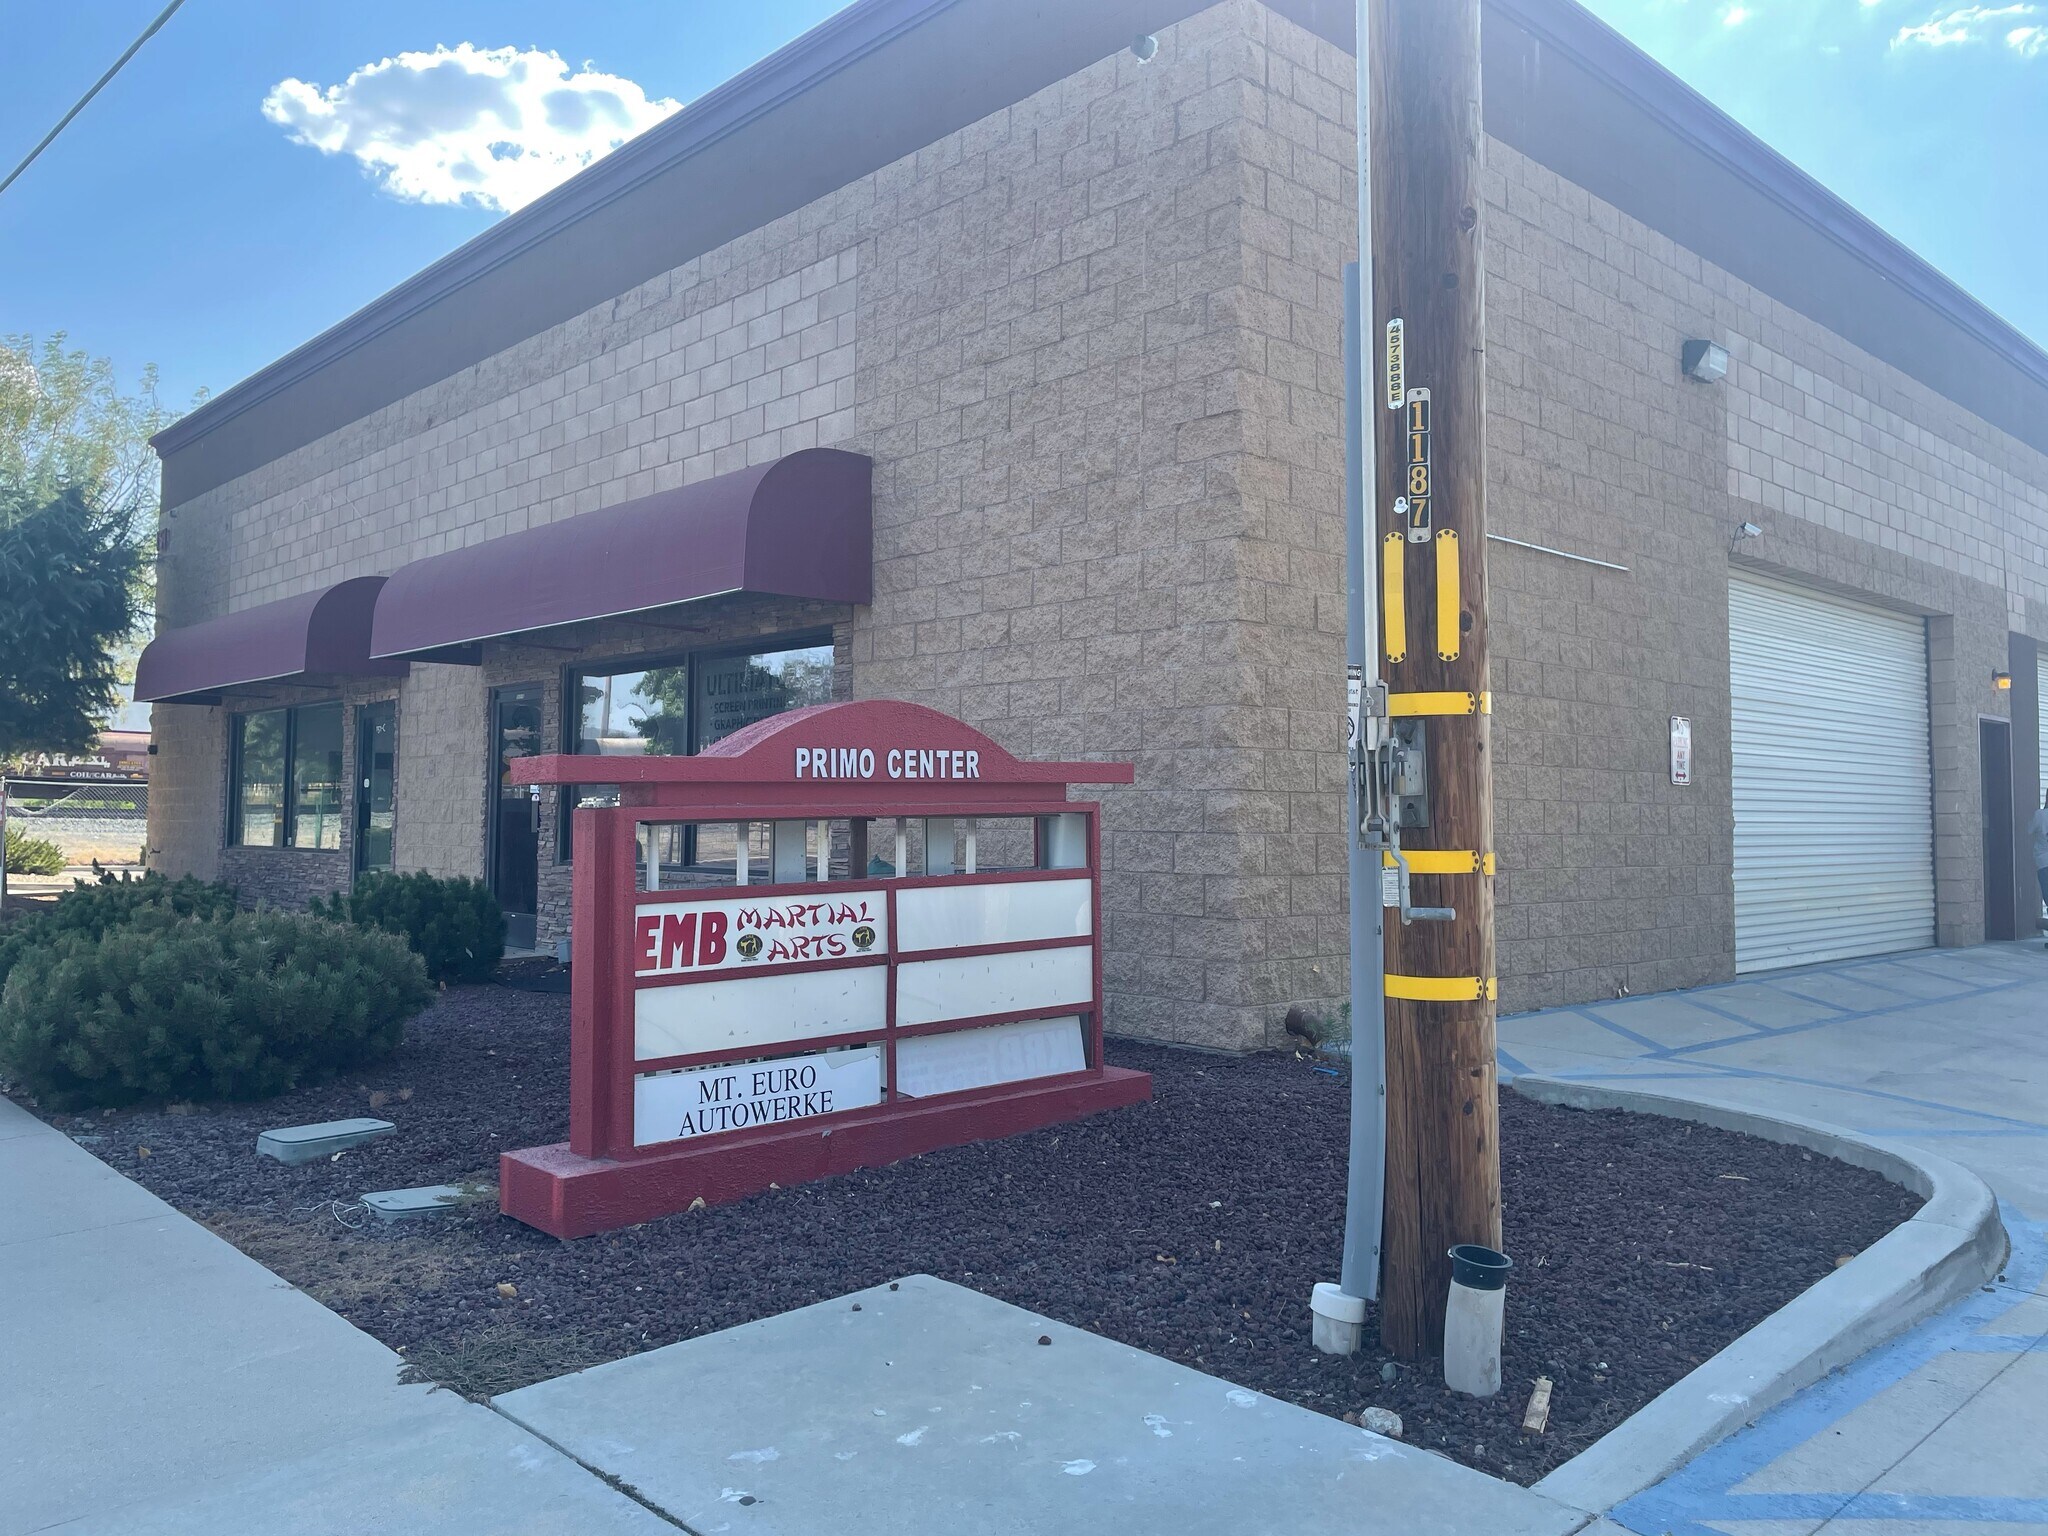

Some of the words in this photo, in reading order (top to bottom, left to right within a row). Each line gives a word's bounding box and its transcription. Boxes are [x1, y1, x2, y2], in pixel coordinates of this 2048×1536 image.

[1389, 325, 1401, 401] 4573888E
[1409, 401, 1428, 527] 1187
[713, 700, 746, 714] SCREEN
[795, 747, 876, 779] PRIMO
[887, 748, 981, 779] CENTER
[736, 901, 876, 931] MARTIAL
[635, 911, 728, 971] EMB
[767, 933, 847, 962] ARTS
[698, 1075, 742, 1105] MT.
[752, 1065, 817, 1096] EURO
[678, 1090, 834, 1137] AUTOWERKE
